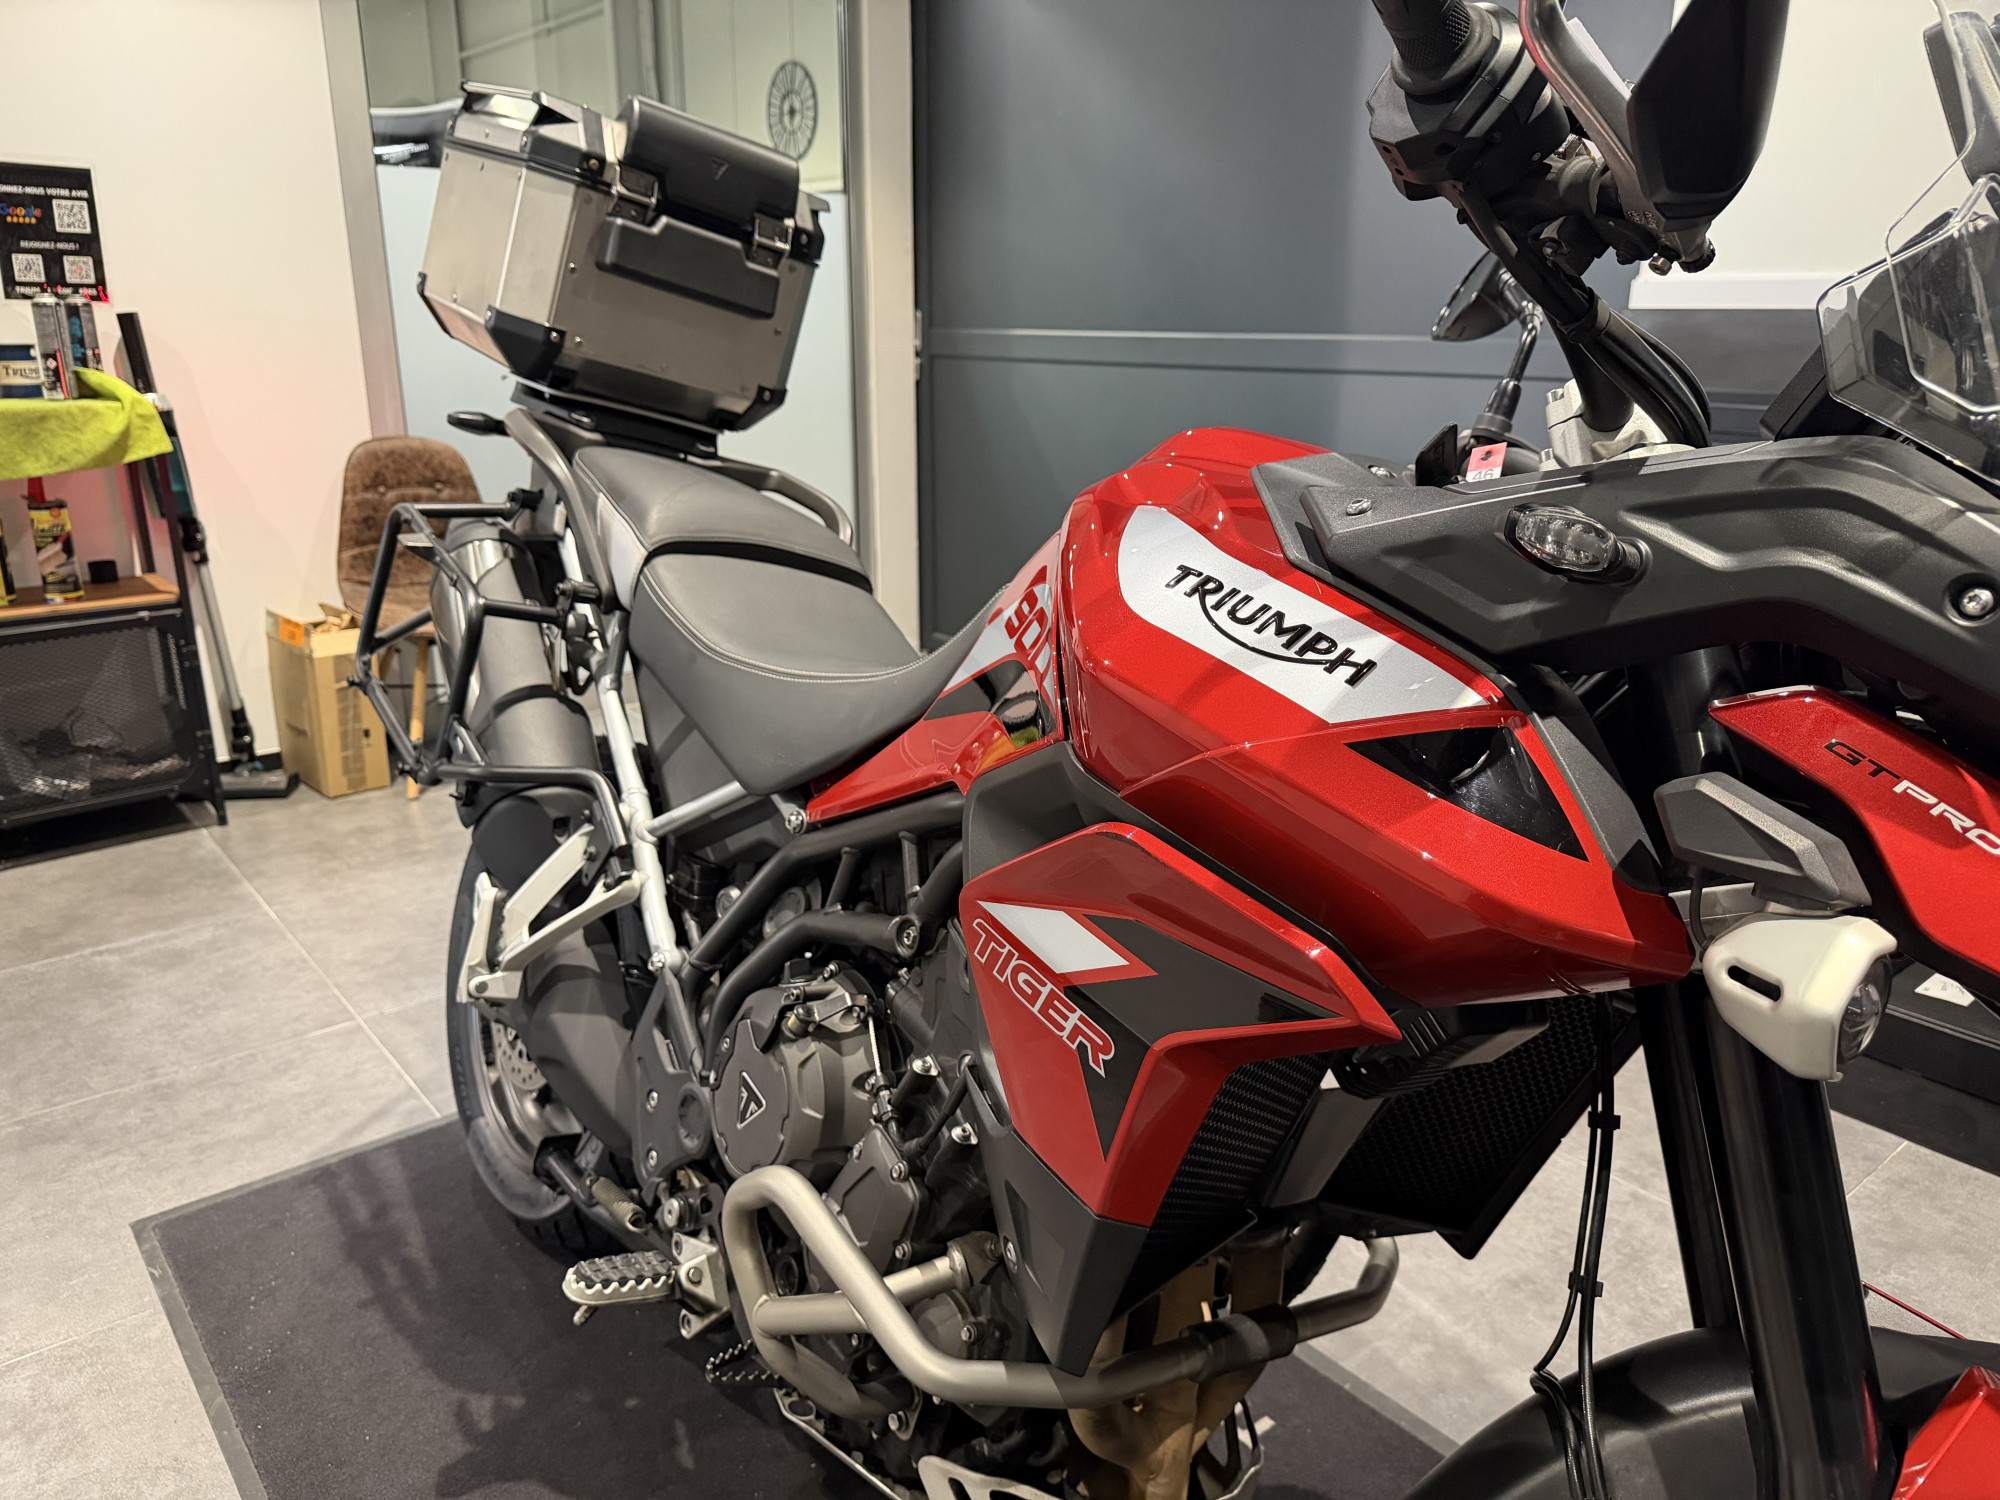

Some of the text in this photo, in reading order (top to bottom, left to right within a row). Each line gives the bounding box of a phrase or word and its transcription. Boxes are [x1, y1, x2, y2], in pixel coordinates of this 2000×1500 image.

[1472, 468, 1494, 480] 46
[1164, 564, 1378, 688] TRIUMPH
[1823, 740, 2000, 856] GT PRO
[972, 918, 1116, 1079] TIGER
